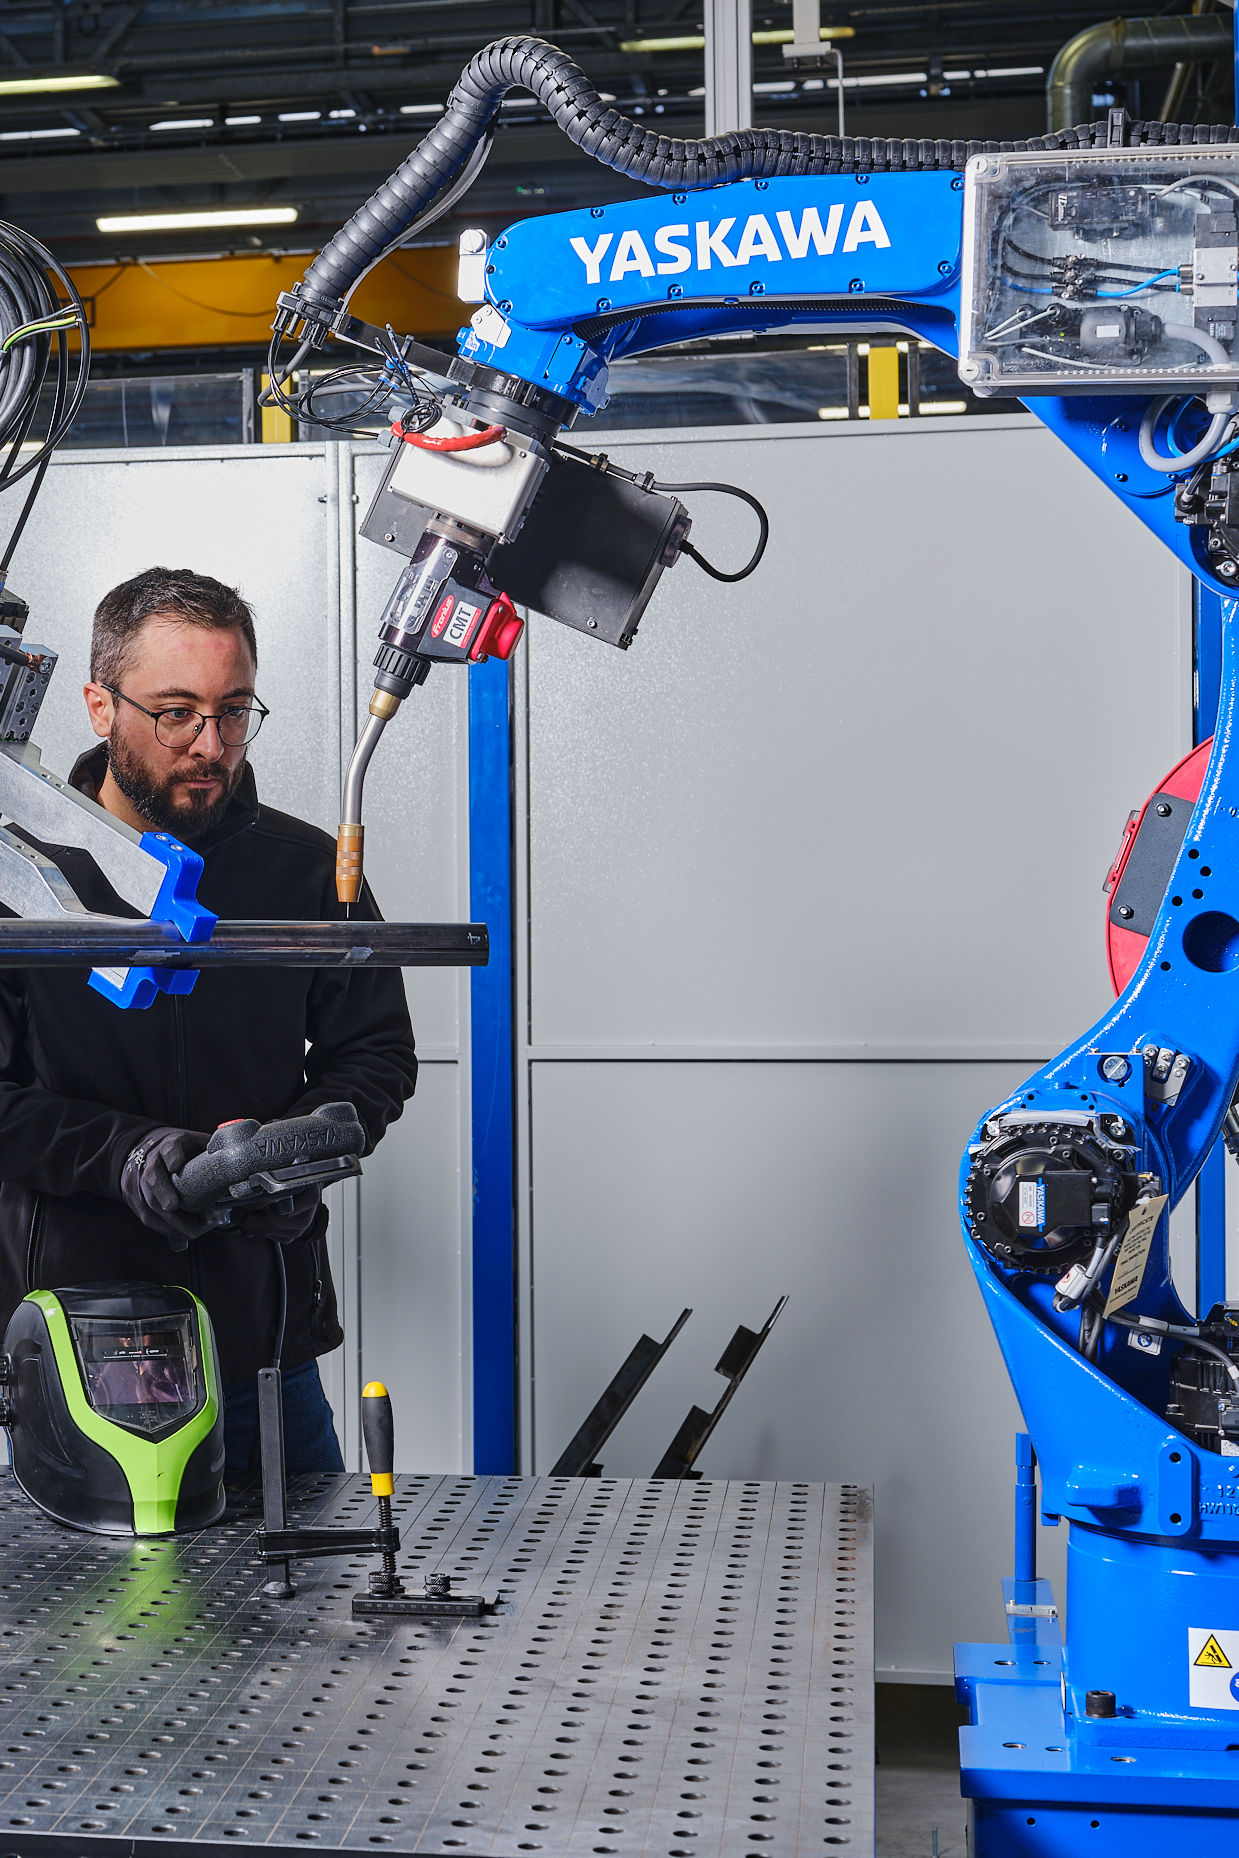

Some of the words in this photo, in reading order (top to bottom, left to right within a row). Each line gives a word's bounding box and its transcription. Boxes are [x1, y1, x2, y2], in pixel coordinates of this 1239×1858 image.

[569, 200, 891, 284] YASKAWA
[432, 597, 453, 635] Fronius
[449, 607, 472, 640] CMT
[255, 1128, 342, 1157] YASKAWA
[1037, 1185, 1045, 1225] YASKAWA
